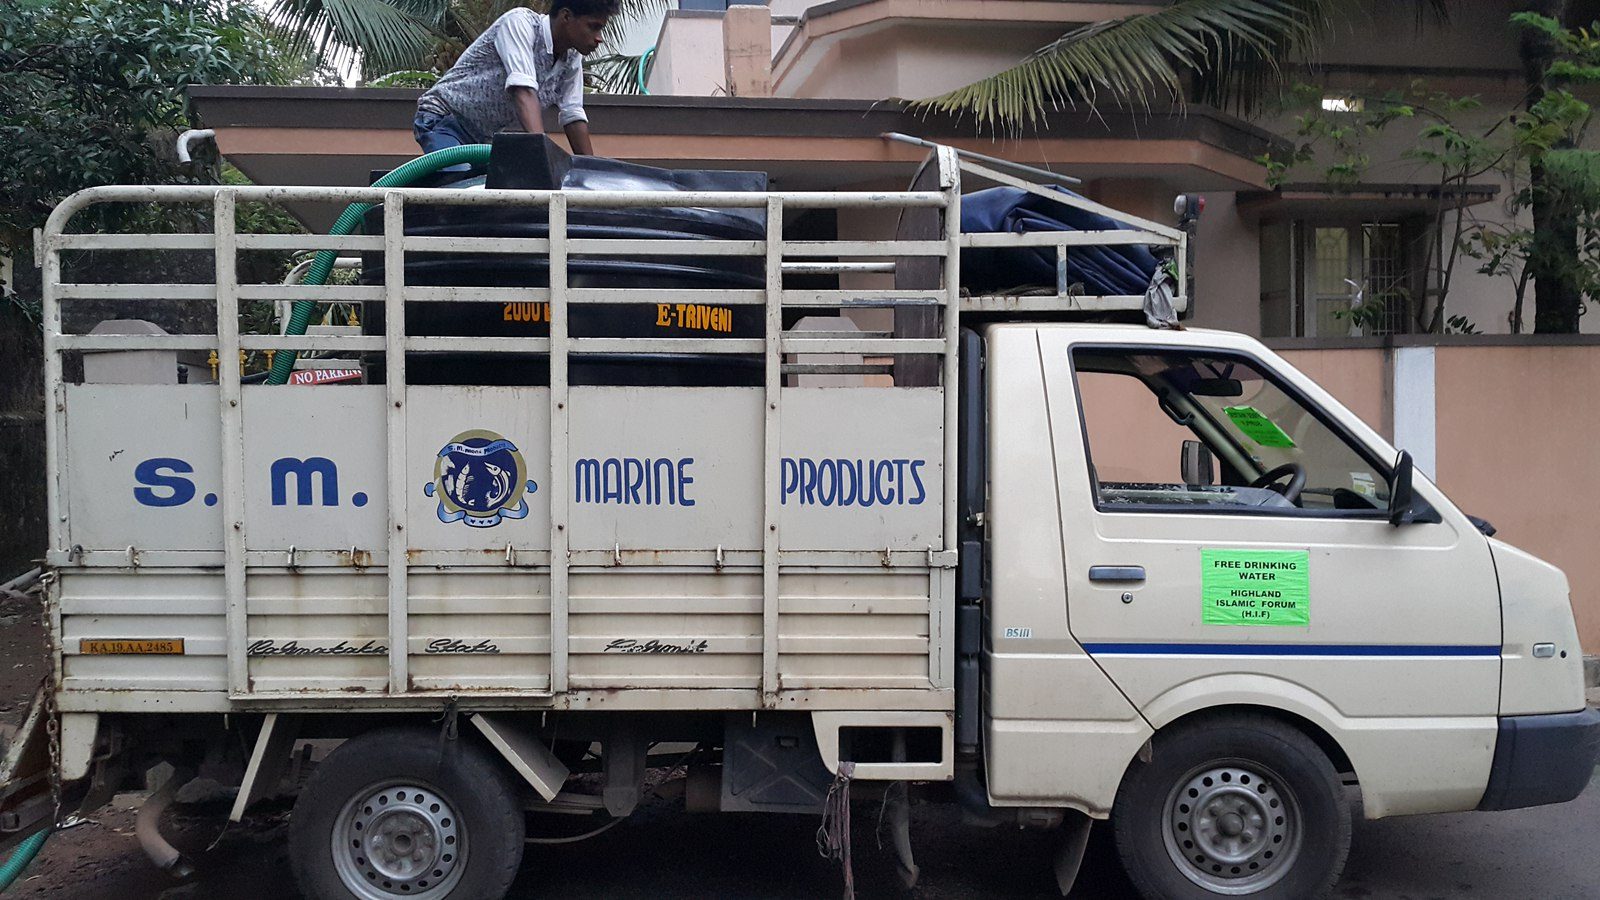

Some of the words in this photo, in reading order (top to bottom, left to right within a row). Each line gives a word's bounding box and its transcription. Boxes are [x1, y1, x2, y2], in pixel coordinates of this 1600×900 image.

[656, 303, 732, 333] E-TRIVENI
[295, 371, 313, 384] NO
[575, 457, 696, 507] MARINE
[781, 457, 926, 507] PRODUCTS
[1214, 560, 1241, 569] FREE
[1244, 561, 1297, 570] DRINKING
[1239, 572, 1276, 581] WATER
[1230, 589, 1282, 598] HIGHLAND
[1216, 599, 1256, 608] ISLAMIC
[1261, 600, 1296, 609] FORUM
[1241, 610, 1271, 619] (H.I.F)
